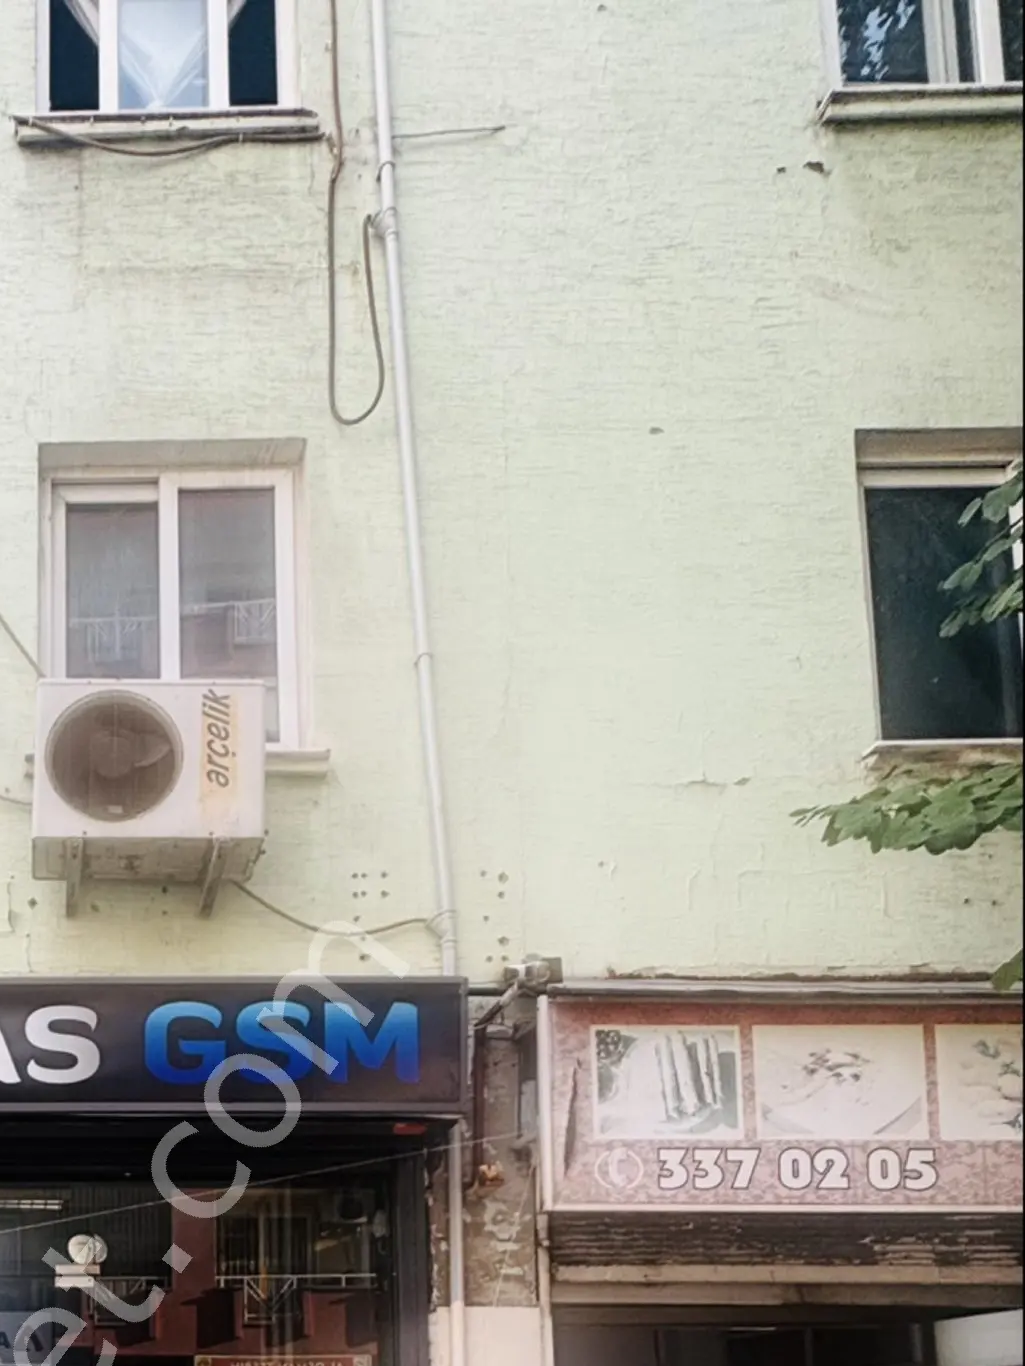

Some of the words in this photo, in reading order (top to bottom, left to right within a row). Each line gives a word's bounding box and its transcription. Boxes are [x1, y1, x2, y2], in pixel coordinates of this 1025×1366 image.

[201, 688, 236, 788] arçelik
[144, 1001, 421, 1085] GSM
[658, 1147, 761, 1191] 337
[777, 1147, 850, 1191] 02
[866, 1147, 938, 1191] 05
